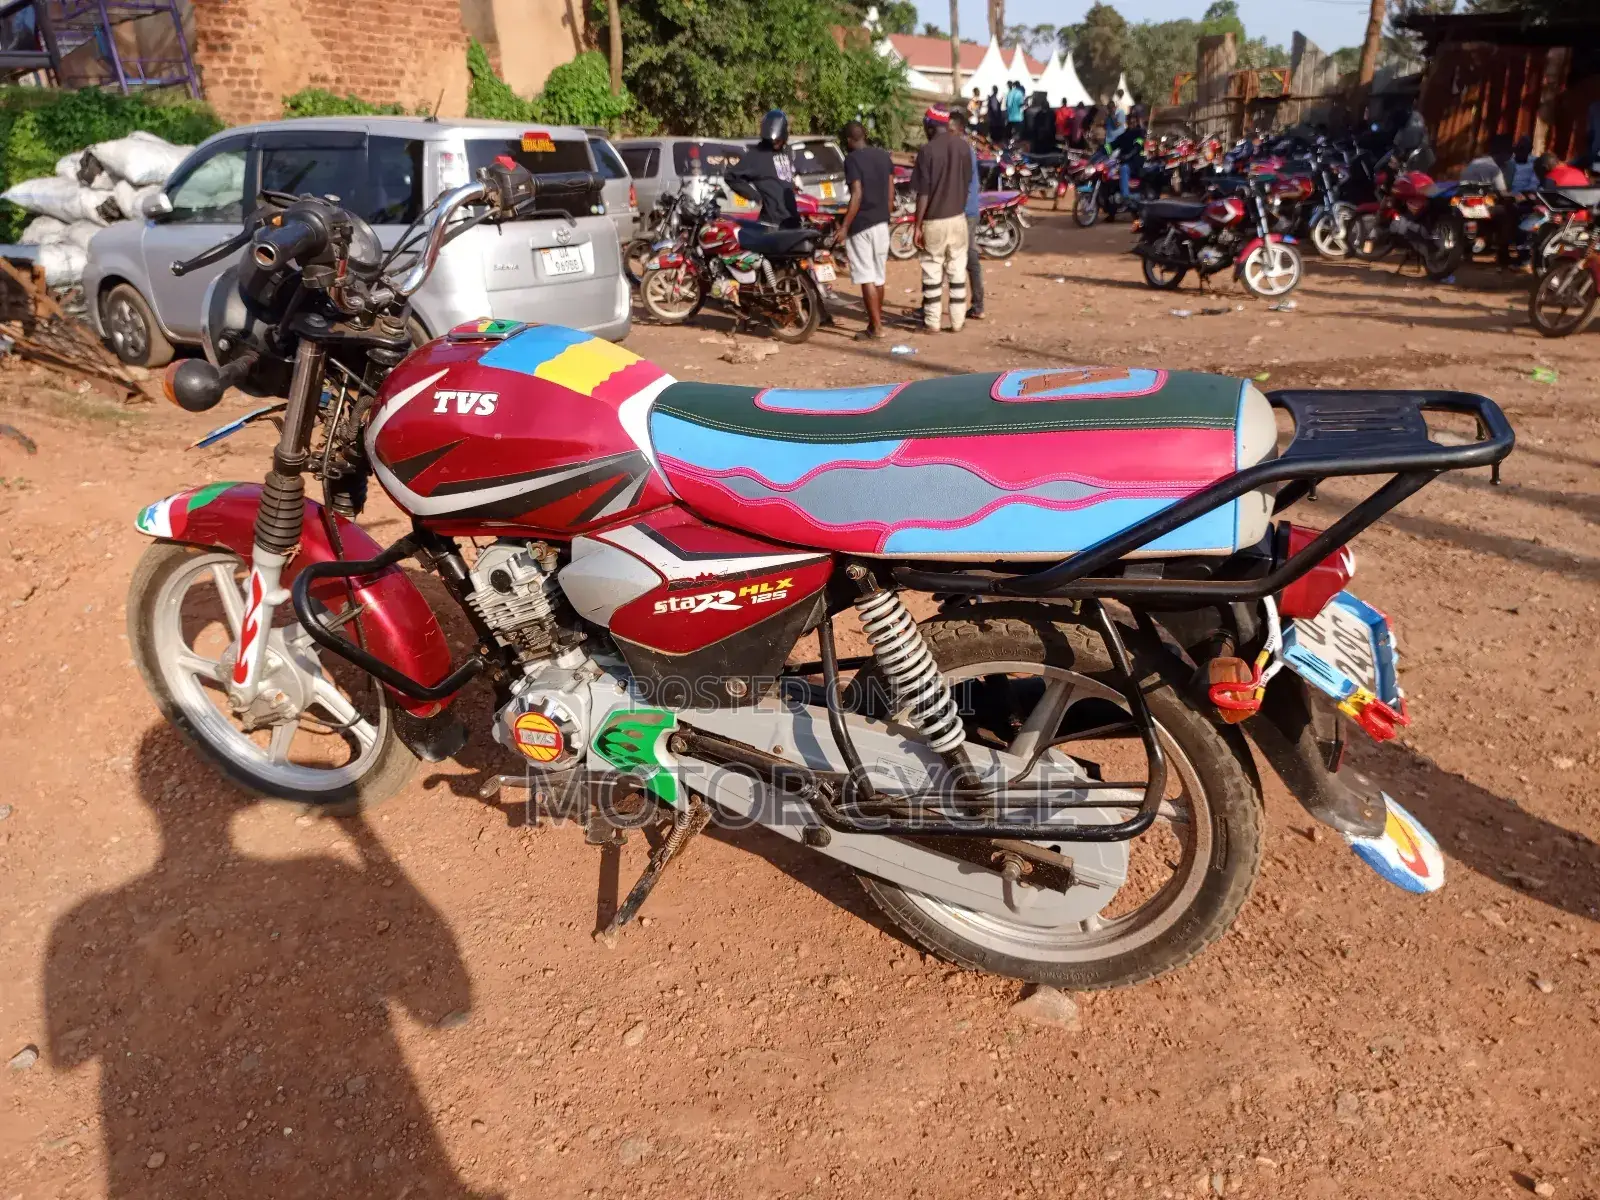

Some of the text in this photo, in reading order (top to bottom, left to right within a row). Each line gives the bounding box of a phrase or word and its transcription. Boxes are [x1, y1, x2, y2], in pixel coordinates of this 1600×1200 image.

[433, 391, 499, 416] TVS
[738, 577, 795, 597] HLX
[751, 589, 788, 605] 125
